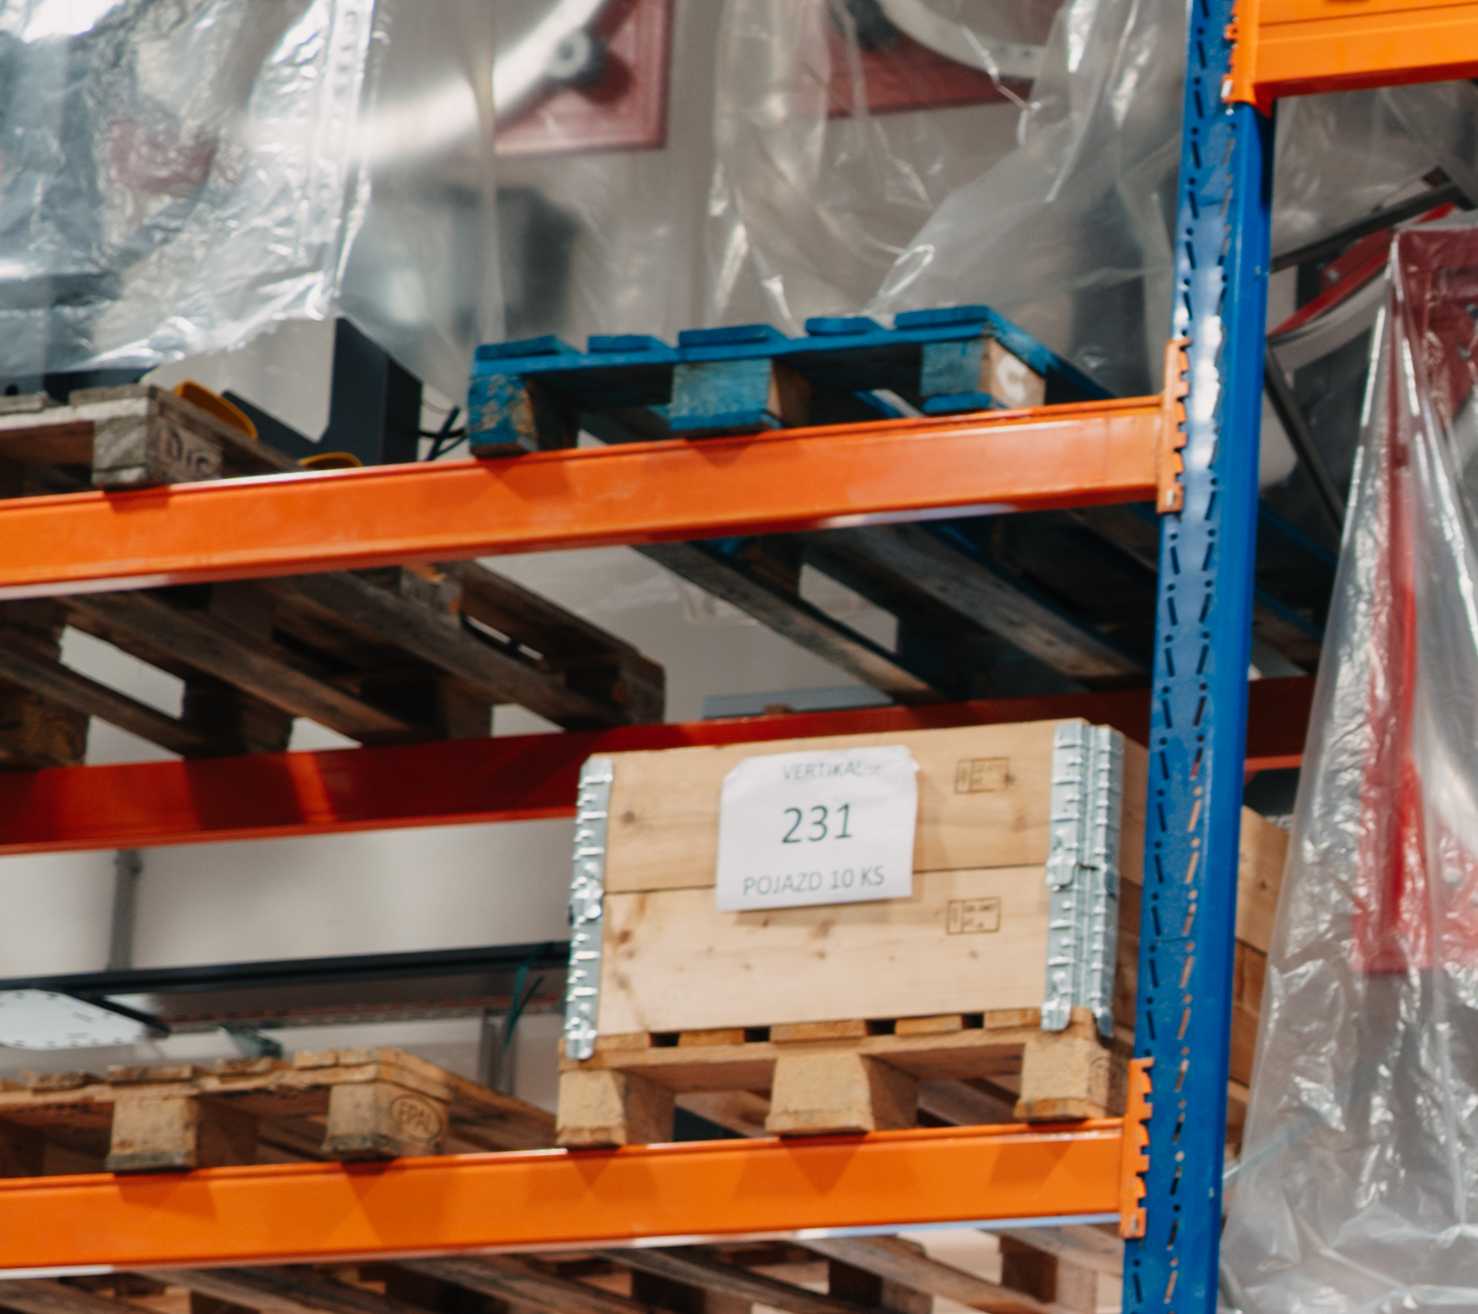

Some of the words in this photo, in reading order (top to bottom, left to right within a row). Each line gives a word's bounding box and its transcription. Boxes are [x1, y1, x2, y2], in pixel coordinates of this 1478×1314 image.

[781, 803, 854, 845] 231
[743, 872, 824, 897] POJAZD
[830, 869, 855, 890] 10
[860, 866, 886, 888] KS
